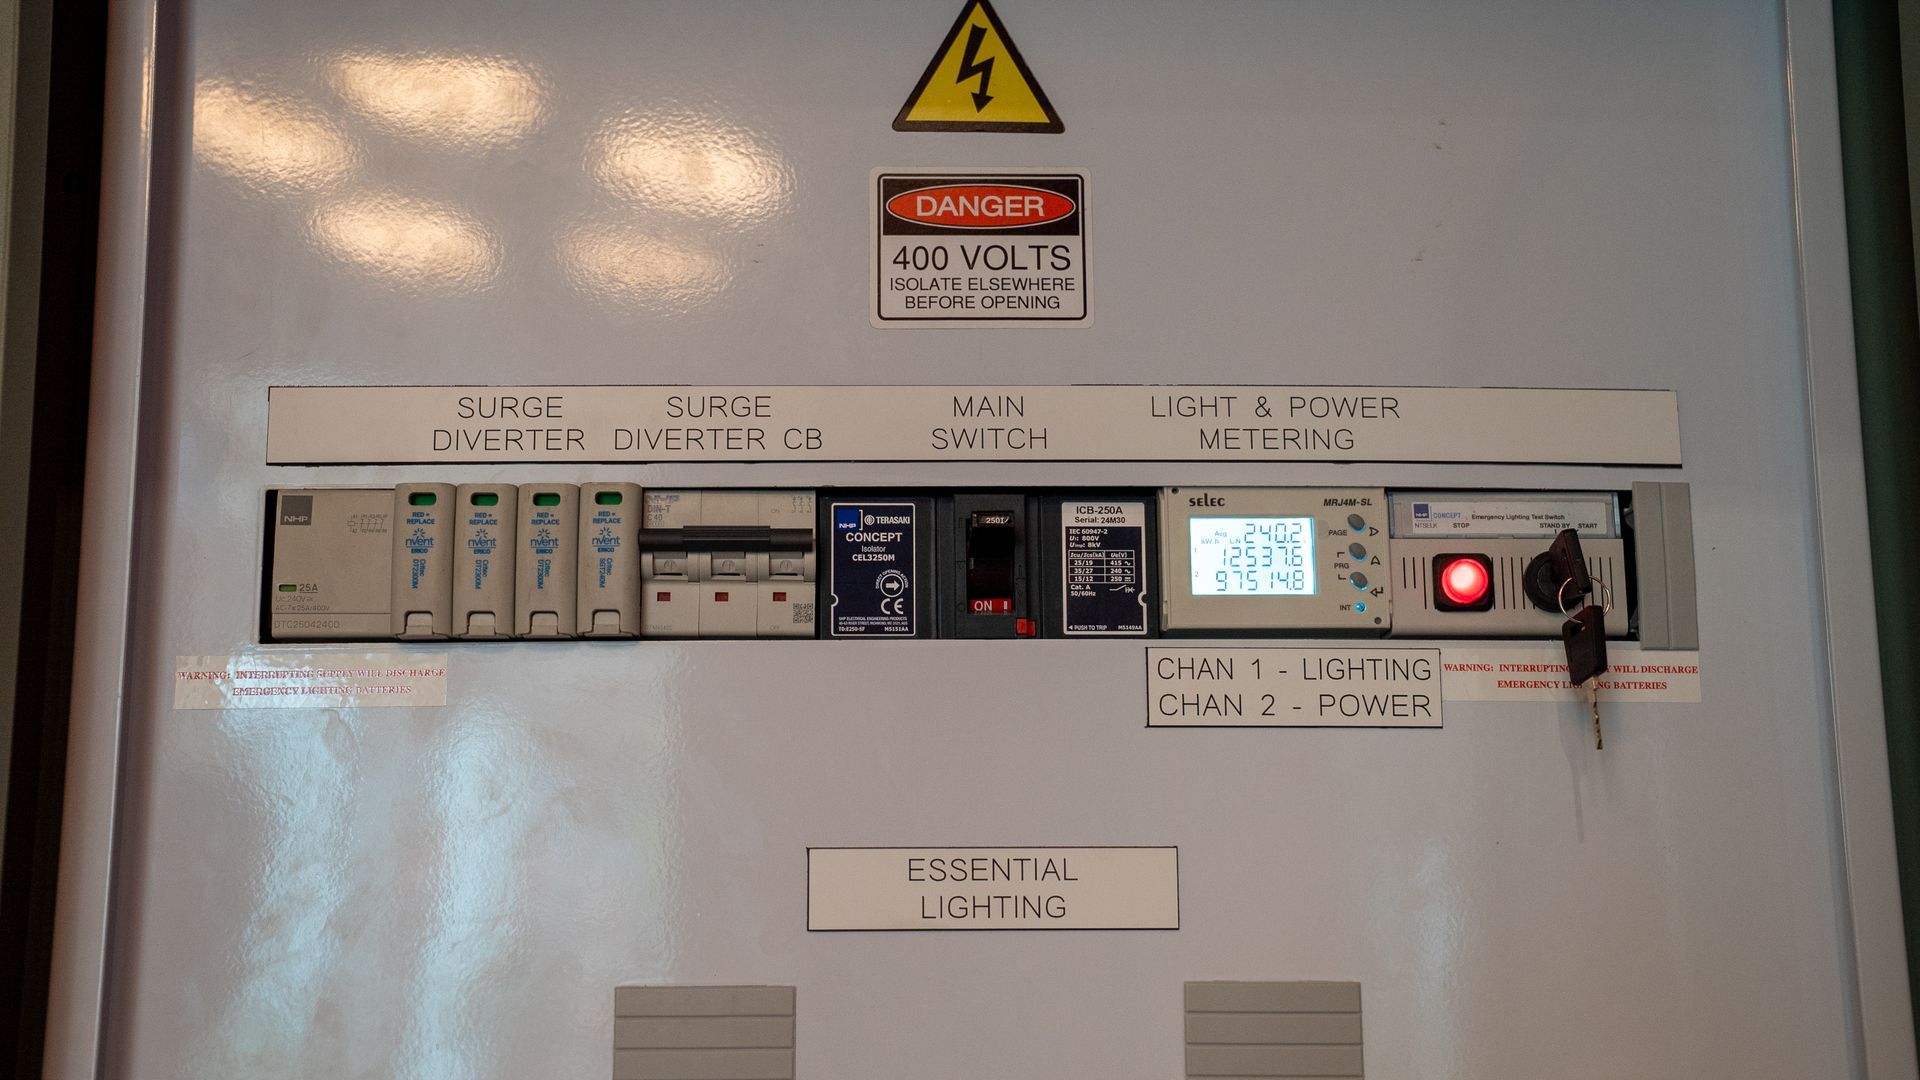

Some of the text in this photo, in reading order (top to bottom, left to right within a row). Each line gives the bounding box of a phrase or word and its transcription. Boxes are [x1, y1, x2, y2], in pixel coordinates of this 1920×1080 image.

[917, 196, 1044, 217] DANGER
[892, 244, 1072, 271] 400 VOLTS
[890, 278, 1076, 291] ISOLATE ELSEWHERE
[905, 296, 1060, 310] BEFORE OPENING
[458, 396, 563, 418] SURGE
[666, 396, 772, 418] SURGE
[952, 396, 1024, 418] MAIN
[1151, 396, 1400, 420] LIGHT & POWER
[432, 428, 586, 452] DIVERTER
[614, 428, 823, 450] DIVERTER CB
[931, 428, 1048, 450] SWITCH
[1200, 428, 1354, 450] METERING
[648, 505, 671, 513] DIN-T
[1076, 506, 1124, 514] ICB-250A
[1323, 498, 1373, 506] MRJ4M-SL
[846, 532, 903, 542] CONCEPT
[1214, 530, 1227, 538] Avg
[1244, 523, 1302, 544] 240.2
[1222, 546, 1303, 567] 12537.6
[298, 584, 318, 592] 25A
[974, 600, 992, 611] ON
[178, 671, 231, 680] WARNING:
[236, 670, 315, 679] INTERRUPTING
[357, 669, 384, 678] WILL
[386, 668, 446, 677] DISCHARGE
[1157, 658, 1233, 680] CHAN
[1252, 658, 1260, 680] 1
[1304, 658, 1431, 681] LIGHTING
[1444, 664, 1494, 672] WARNING:
[1613, 665, 1640, 673] WILL
[1640, 666, 1698, 674] DISCHARGE
[232, 686, 412, 696] EMERGENCY LIGHTING BATTERIES
[1497, 680, 1559, 689] EMERGENCY
[1613, 681, 1668, 690] BATTERIES
[1159, 694, 1242, 716] CHAN
[1261, 694, 1275, 716] 2
[1319, 694, 1431, 717] POWER
[908, 858, 1078, 882] ESSENTIAL
[922, 896, 1066, 918] LIGHTING
